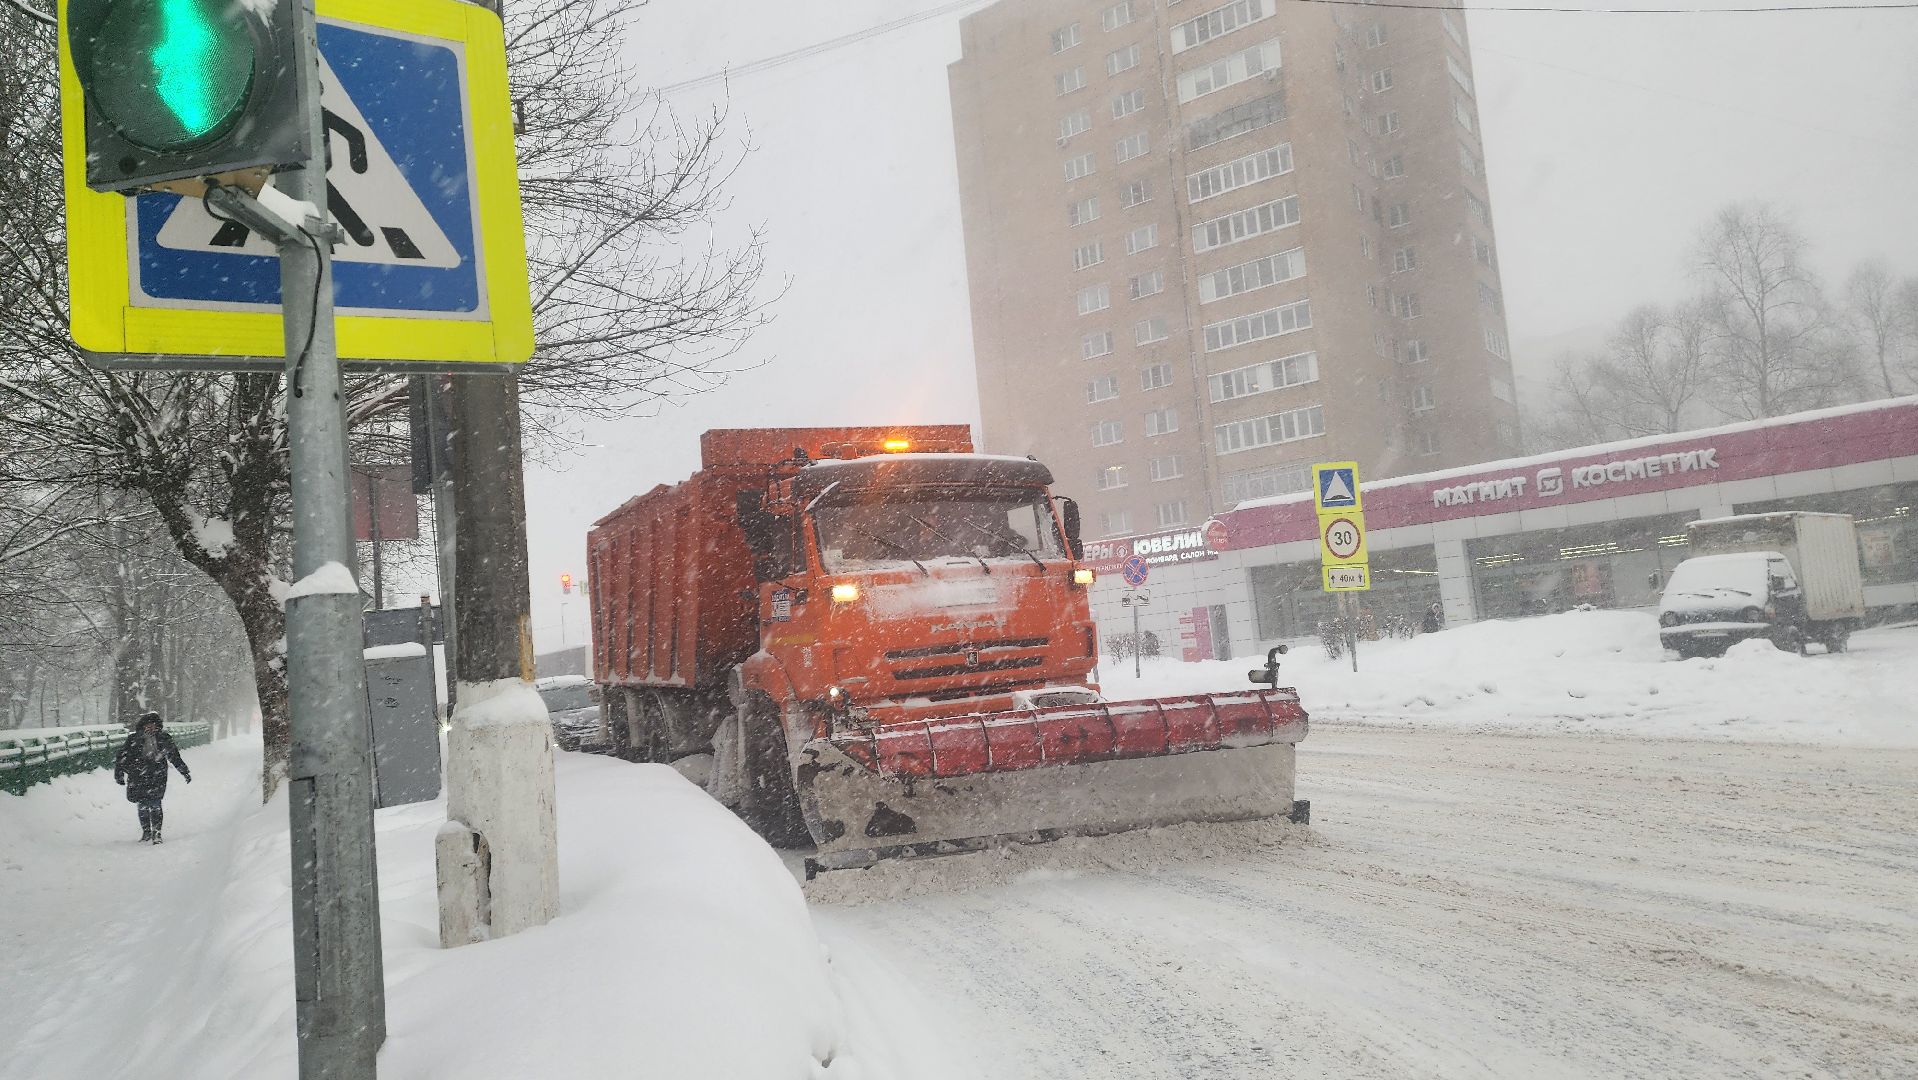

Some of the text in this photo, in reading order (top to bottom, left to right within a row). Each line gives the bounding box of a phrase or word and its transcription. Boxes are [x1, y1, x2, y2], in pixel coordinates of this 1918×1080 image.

[1433, 448, 1720, 508] МАГНИТ КОСМЕТИК
[1334, 530, 1352, 546] 30
[1083, 543, 1114, 562] ЕРЫ
[1180, 550, 1205, 560] САЛОН
